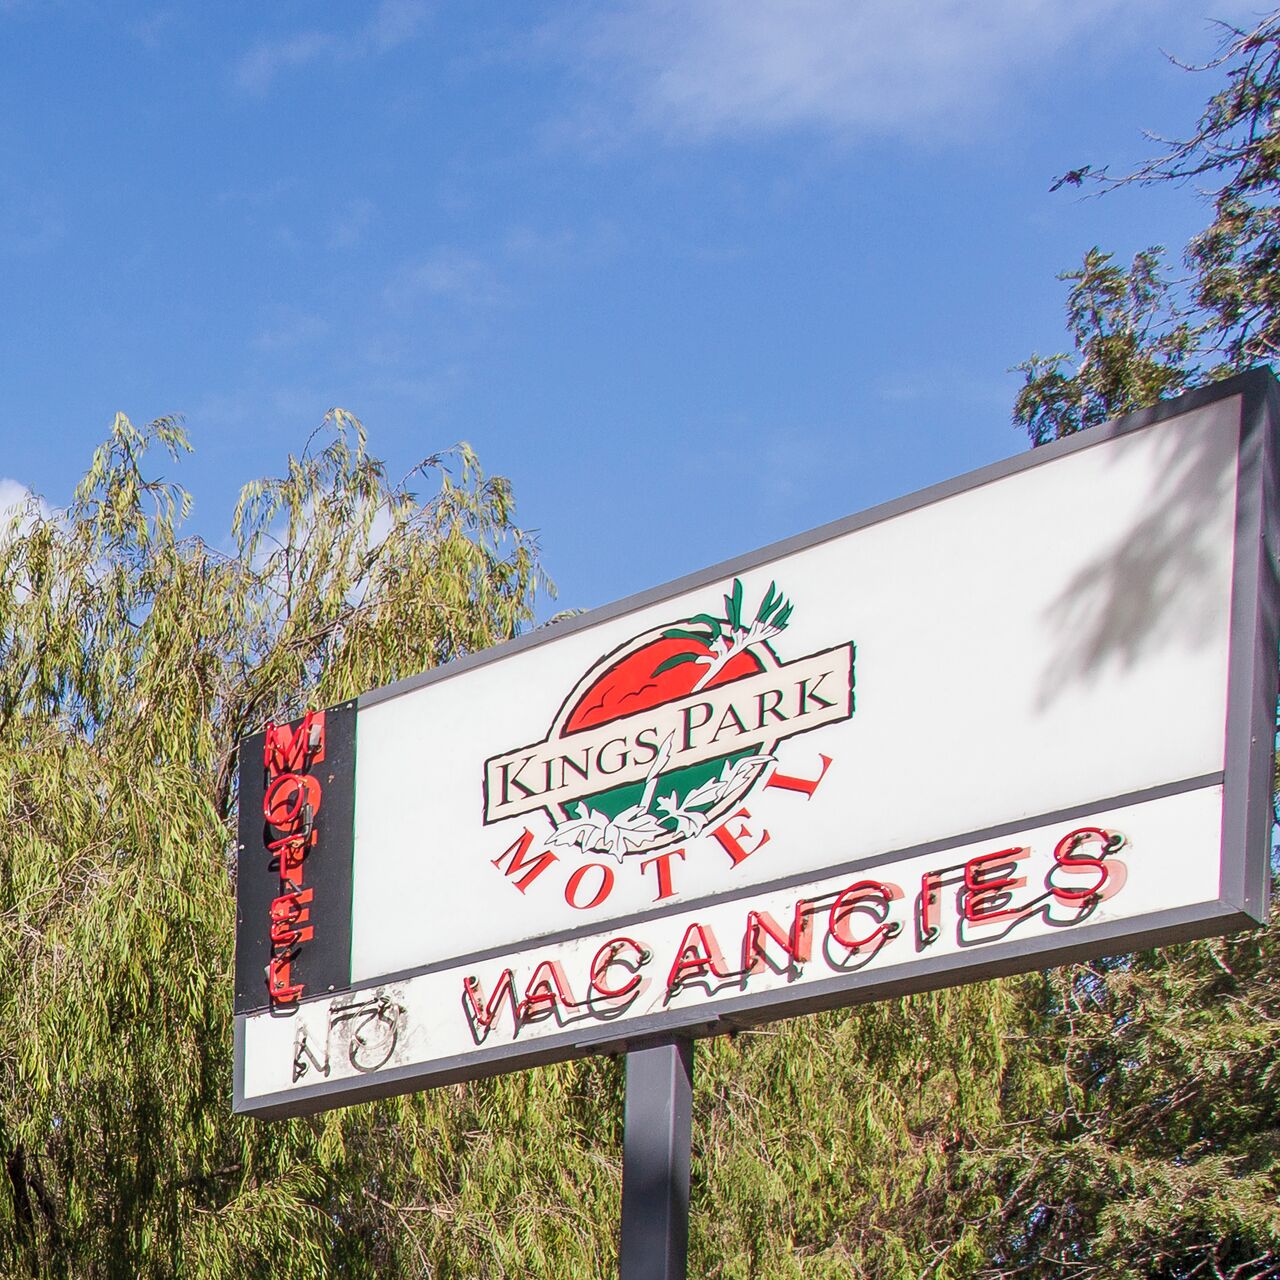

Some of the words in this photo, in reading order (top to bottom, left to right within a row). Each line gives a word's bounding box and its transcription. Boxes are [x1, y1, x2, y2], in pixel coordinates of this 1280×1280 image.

[495, 727, 660, 807] KINGS
[677, 670, 838, 754] PARK
[263, 709, 328, 1004] MOTEL
[490, 752, 833, 910] MOTEL
[462, 827, 1128, 1028] VACANCIES
